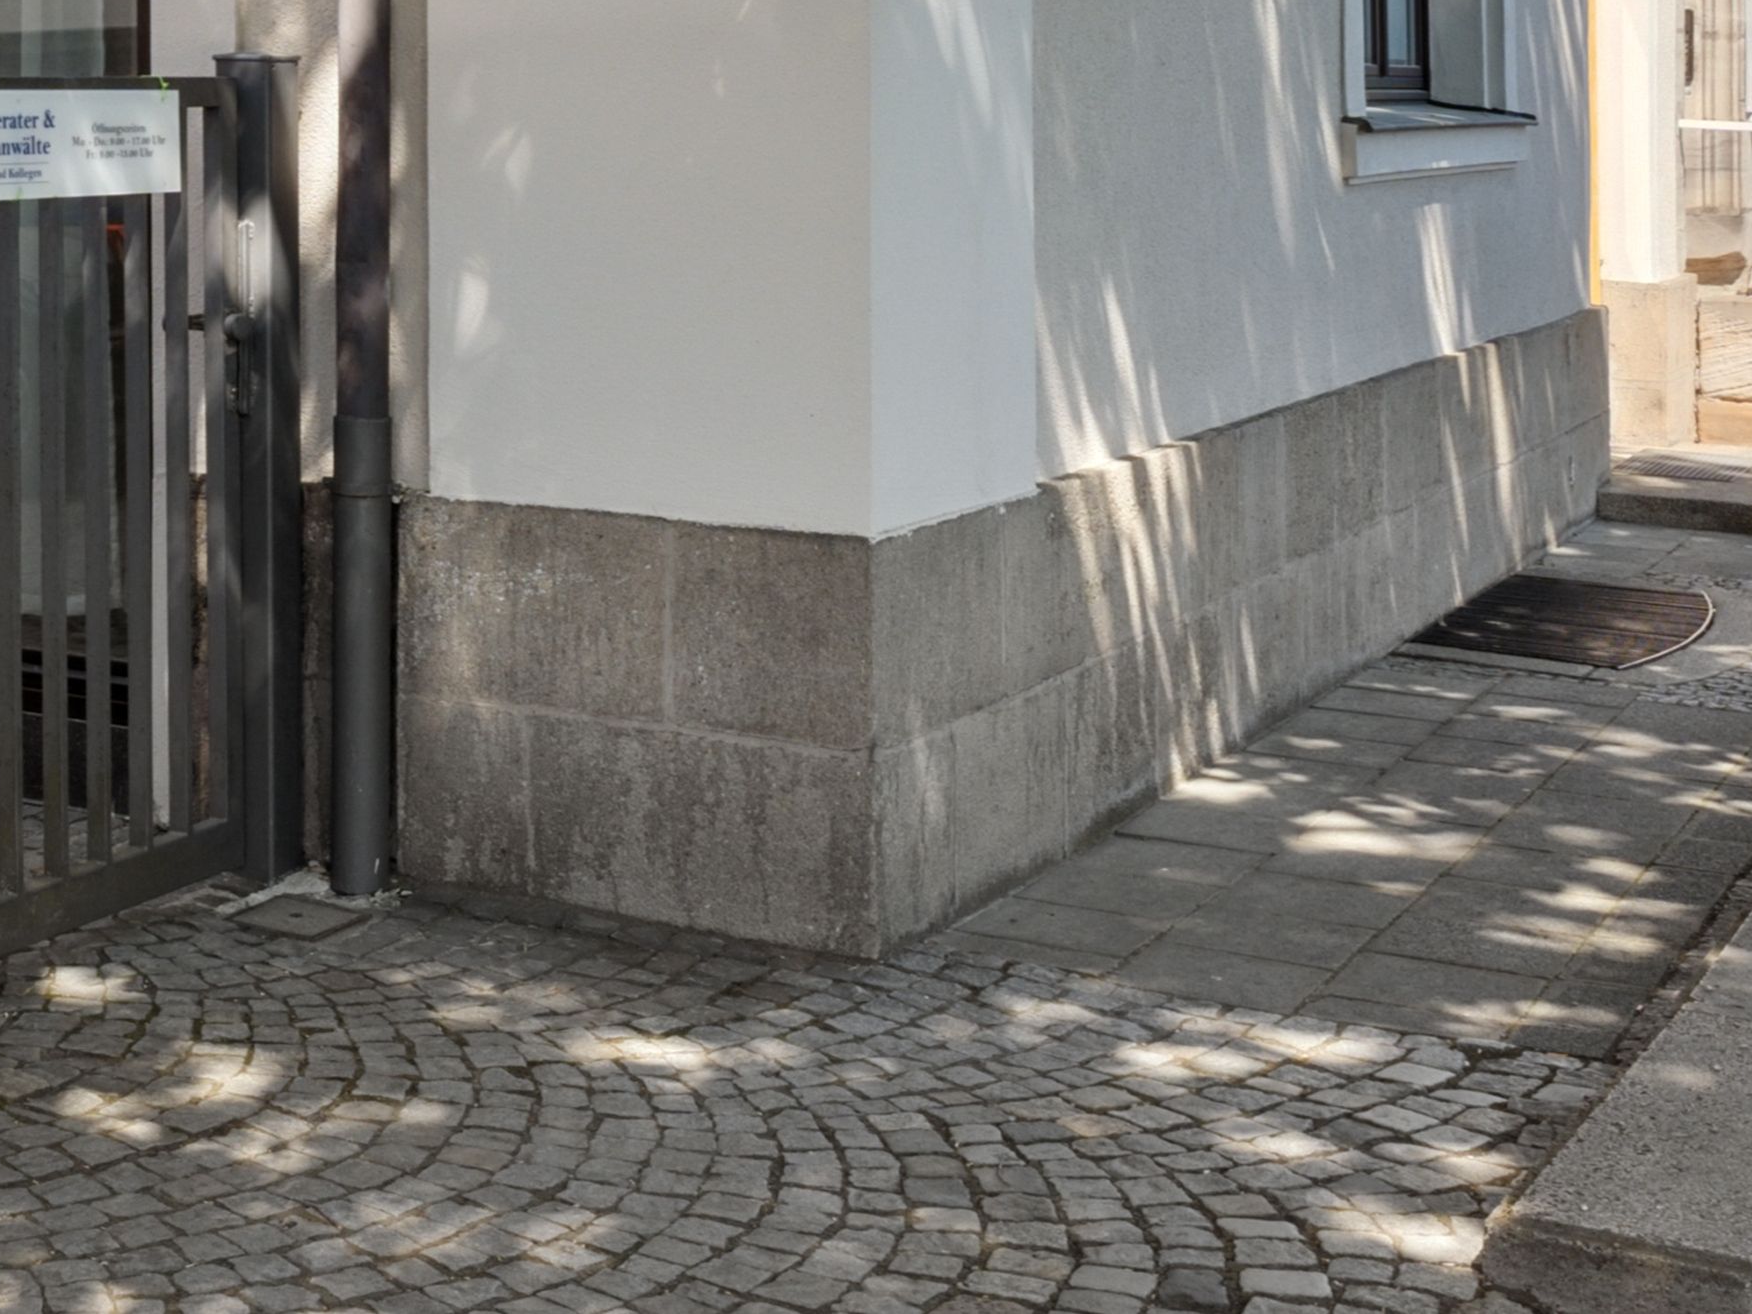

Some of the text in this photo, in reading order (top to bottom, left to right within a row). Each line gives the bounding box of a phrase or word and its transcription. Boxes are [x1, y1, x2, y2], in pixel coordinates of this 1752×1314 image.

[43, 109, 56, 129] &
[91, 122, 147, 136] Öffnungszeiten
[151, 135, 166, 145] Uhr
[139, 147, 153, 158] Uhr
[8, 167, 43, 181] Kollegen
